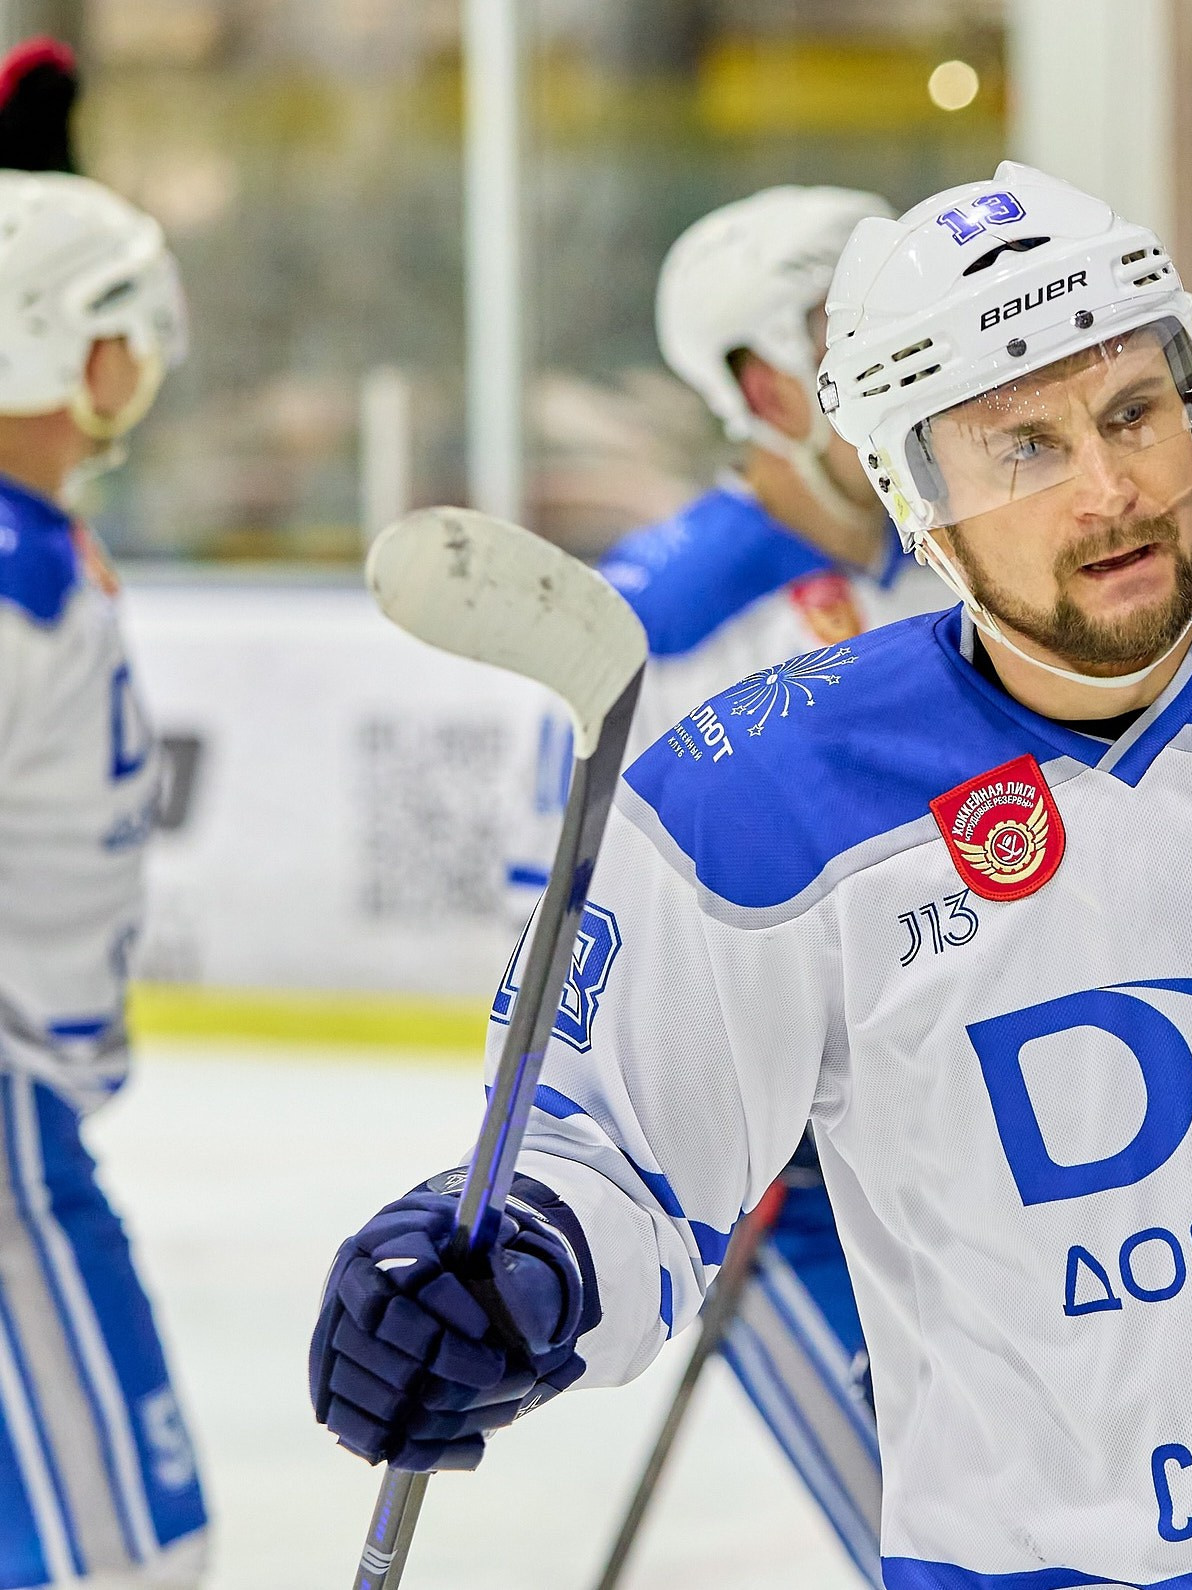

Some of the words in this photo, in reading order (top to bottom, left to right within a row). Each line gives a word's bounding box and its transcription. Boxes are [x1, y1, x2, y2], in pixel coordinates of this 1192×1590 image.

[937, 191, 1026, 246] 13
[951, 782, 1004, 837] ХОККЕЙНАЯ
[1005, 781, 1036, 800] ЛИГА
[898, 888, 979, 967] J13
